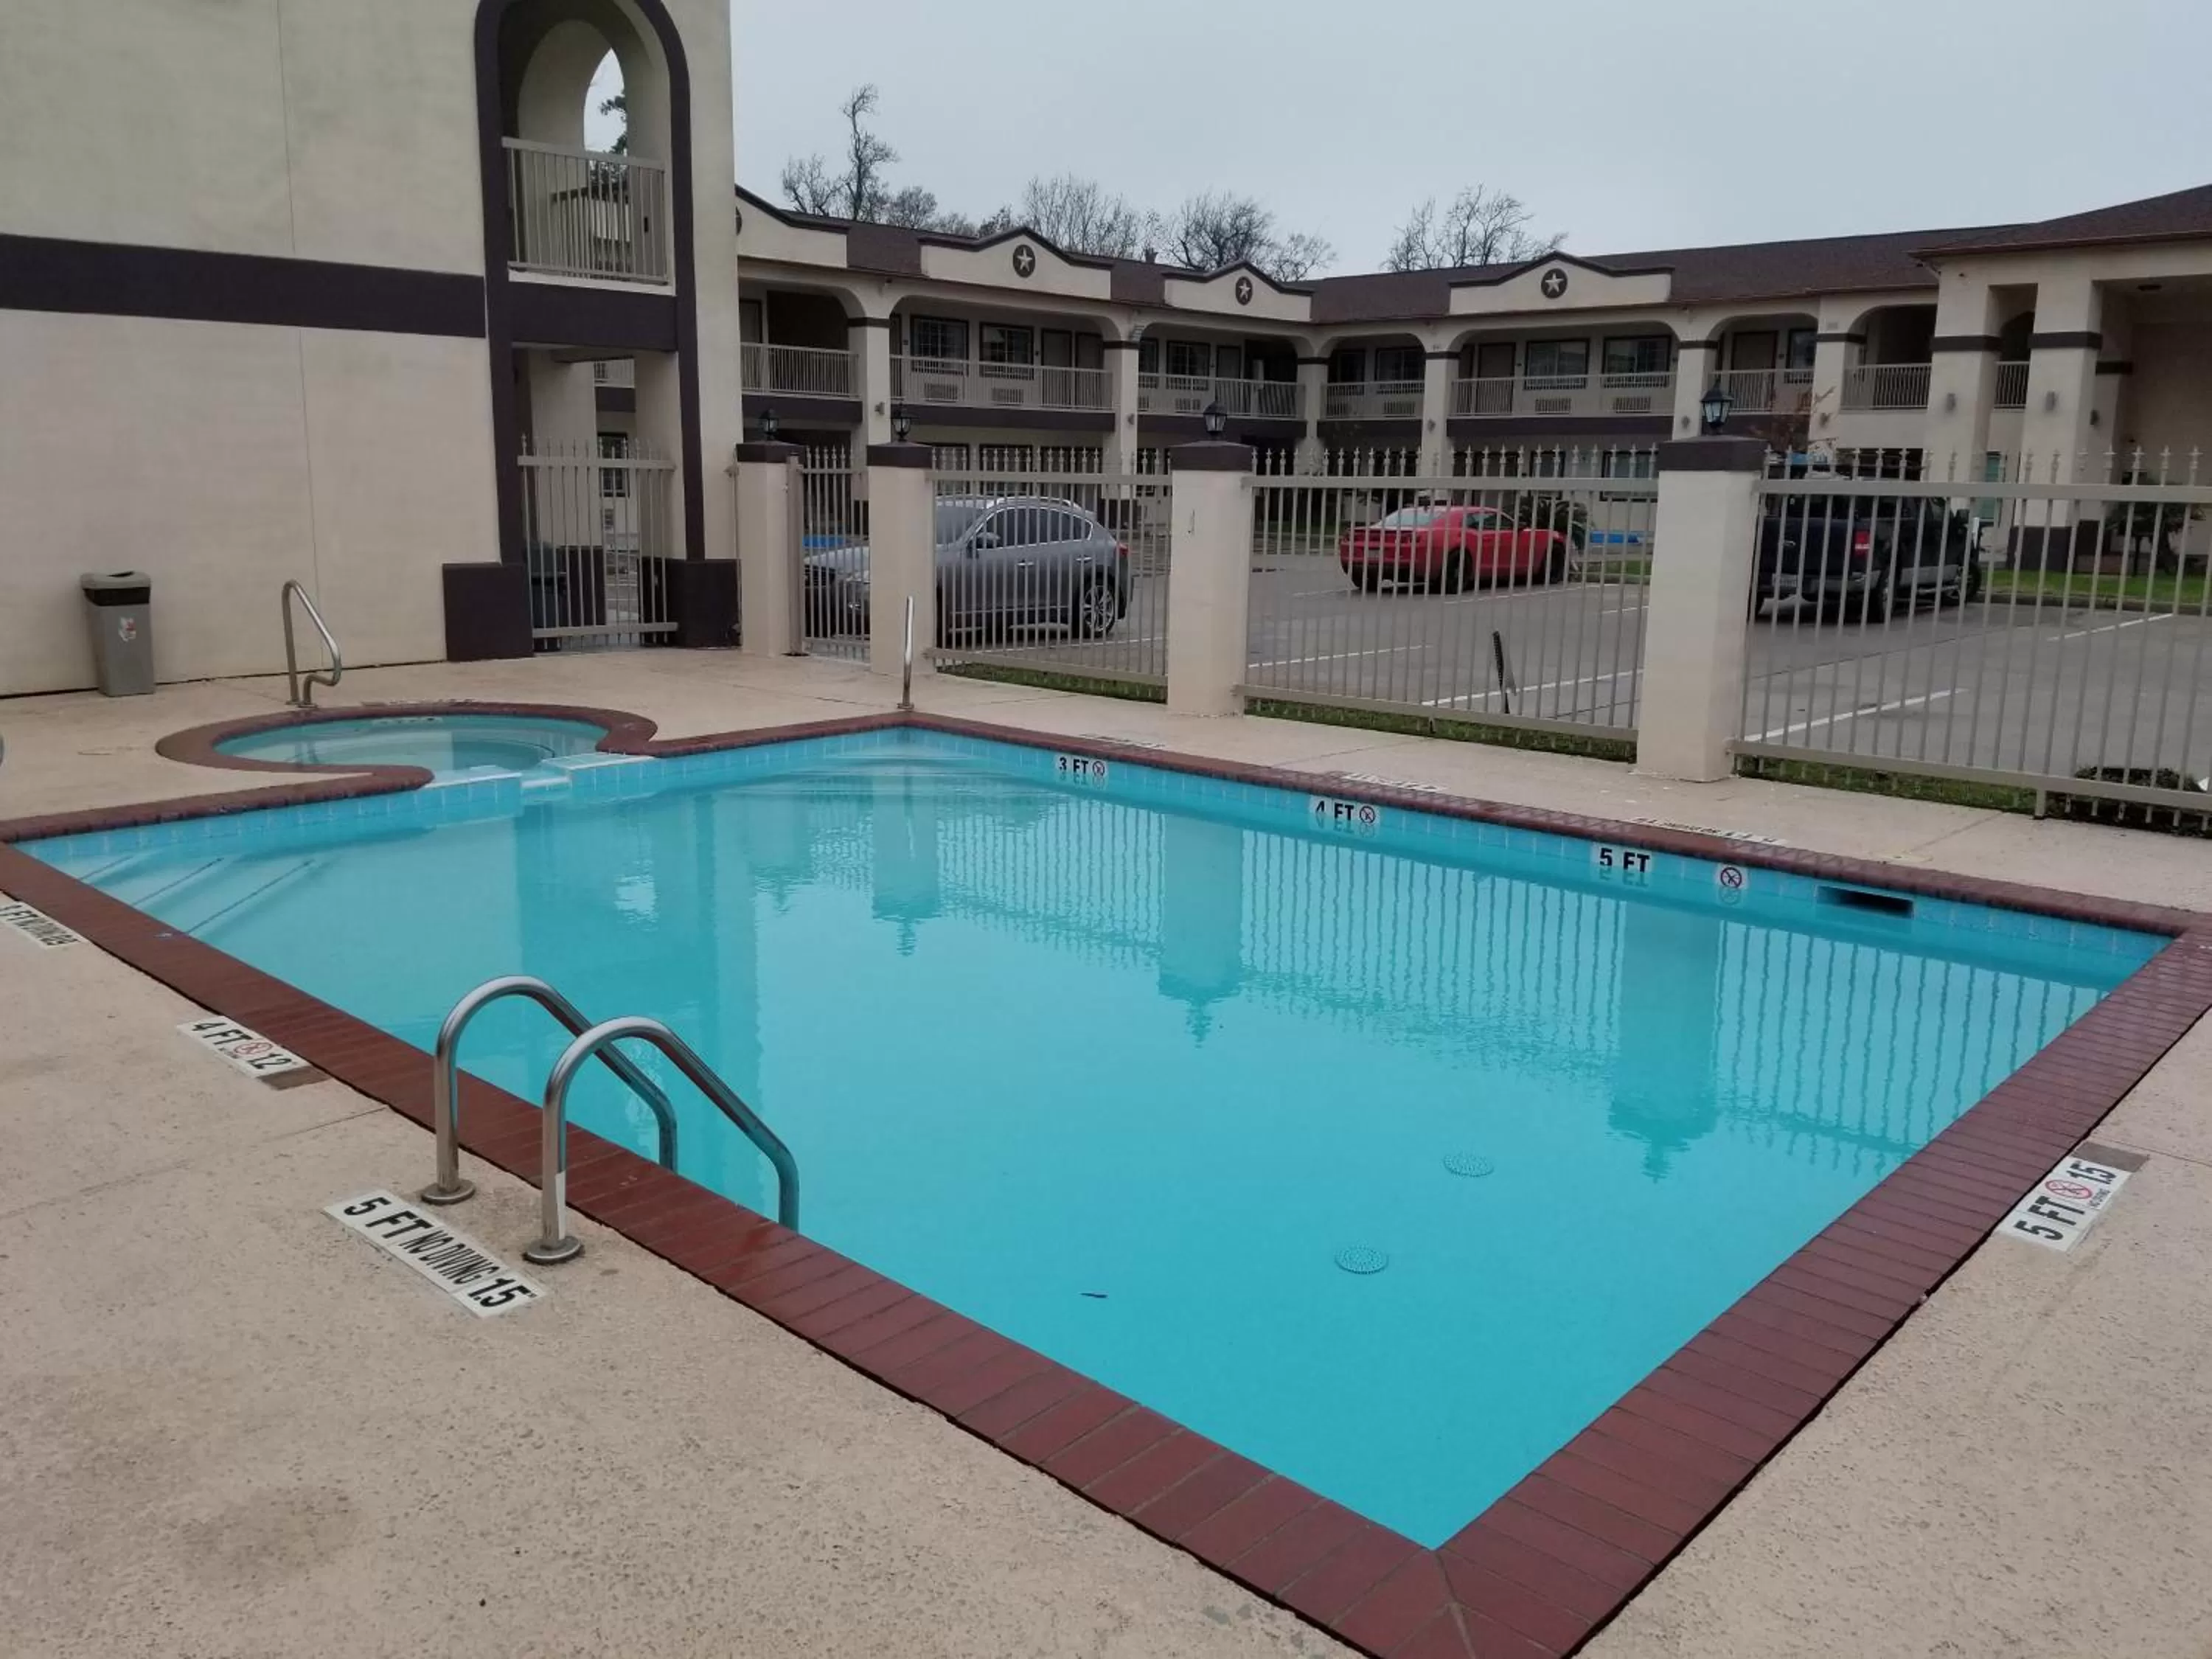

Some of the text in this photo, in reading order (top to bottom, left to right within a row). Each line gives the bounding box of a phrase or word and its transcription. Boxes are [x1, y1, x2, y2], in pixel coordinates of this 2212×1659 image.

[1059, 757, 1089, 774] 3 FT
[1334, 802, 1354, 821] FT
[1599, 847, 1650, 873] 5 FT
[192, 1022, 227, 1032] 4
[202, 1029, 252, 1045] FT
[344, 1197, 392, 1216] 5
[2028, 1195, 2086, 1226] FT
[365, 1210, 434, 1239] FT
[2014, 1220, 2064, 1241] 5
[398, 1229, 454, 1254] NO
[418, 1242, 500, 1284] DIVING
